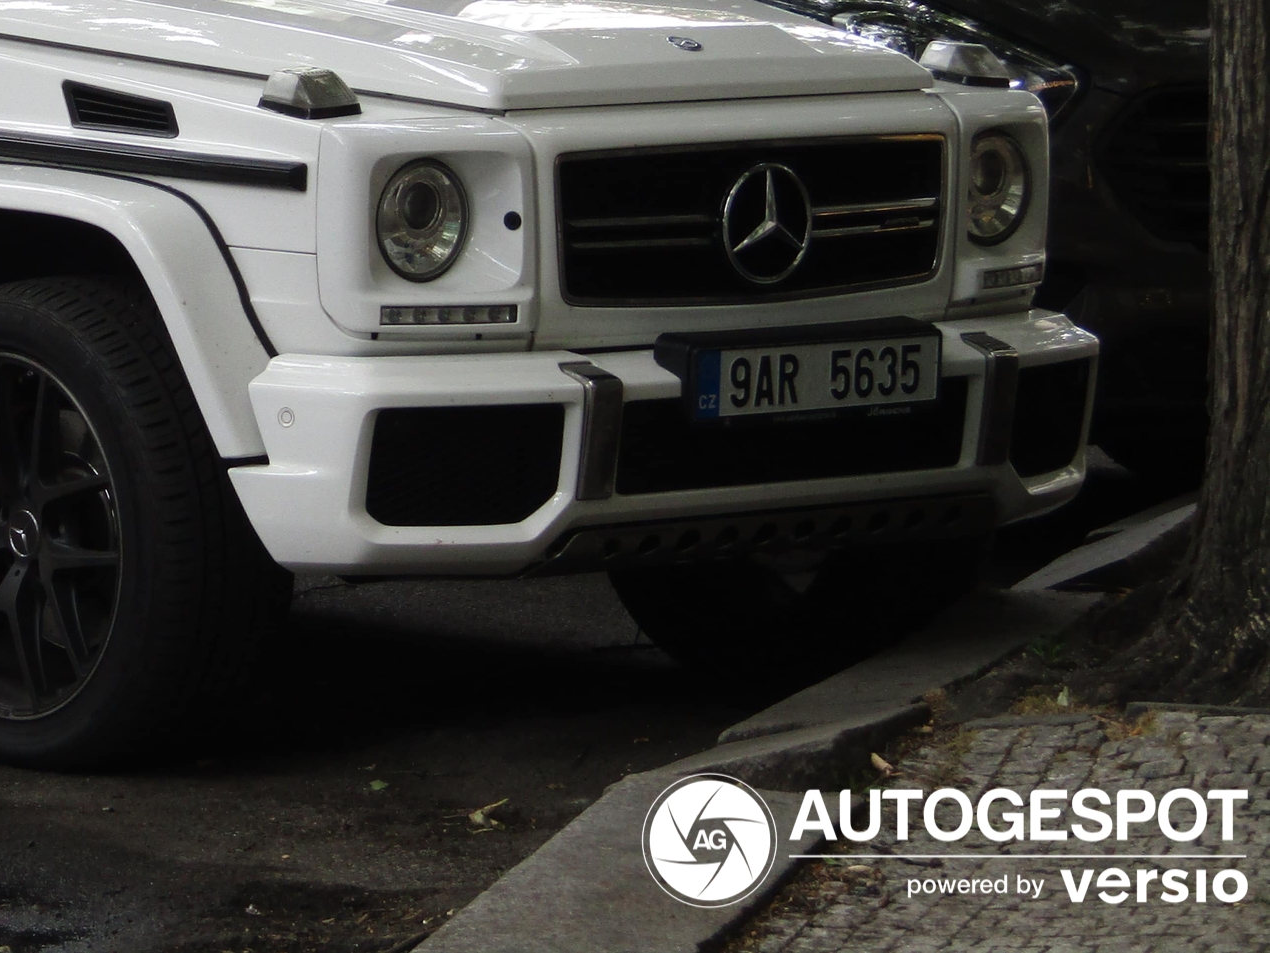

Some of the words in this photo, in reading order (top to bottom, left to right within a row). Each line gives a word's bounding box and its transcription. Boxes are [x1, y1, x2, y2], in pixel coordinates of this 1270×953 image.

[698, 394, 717, 410] CZ
[730, 353, 799, 408] 9AR
[830, 344, 921, 400] 5635
